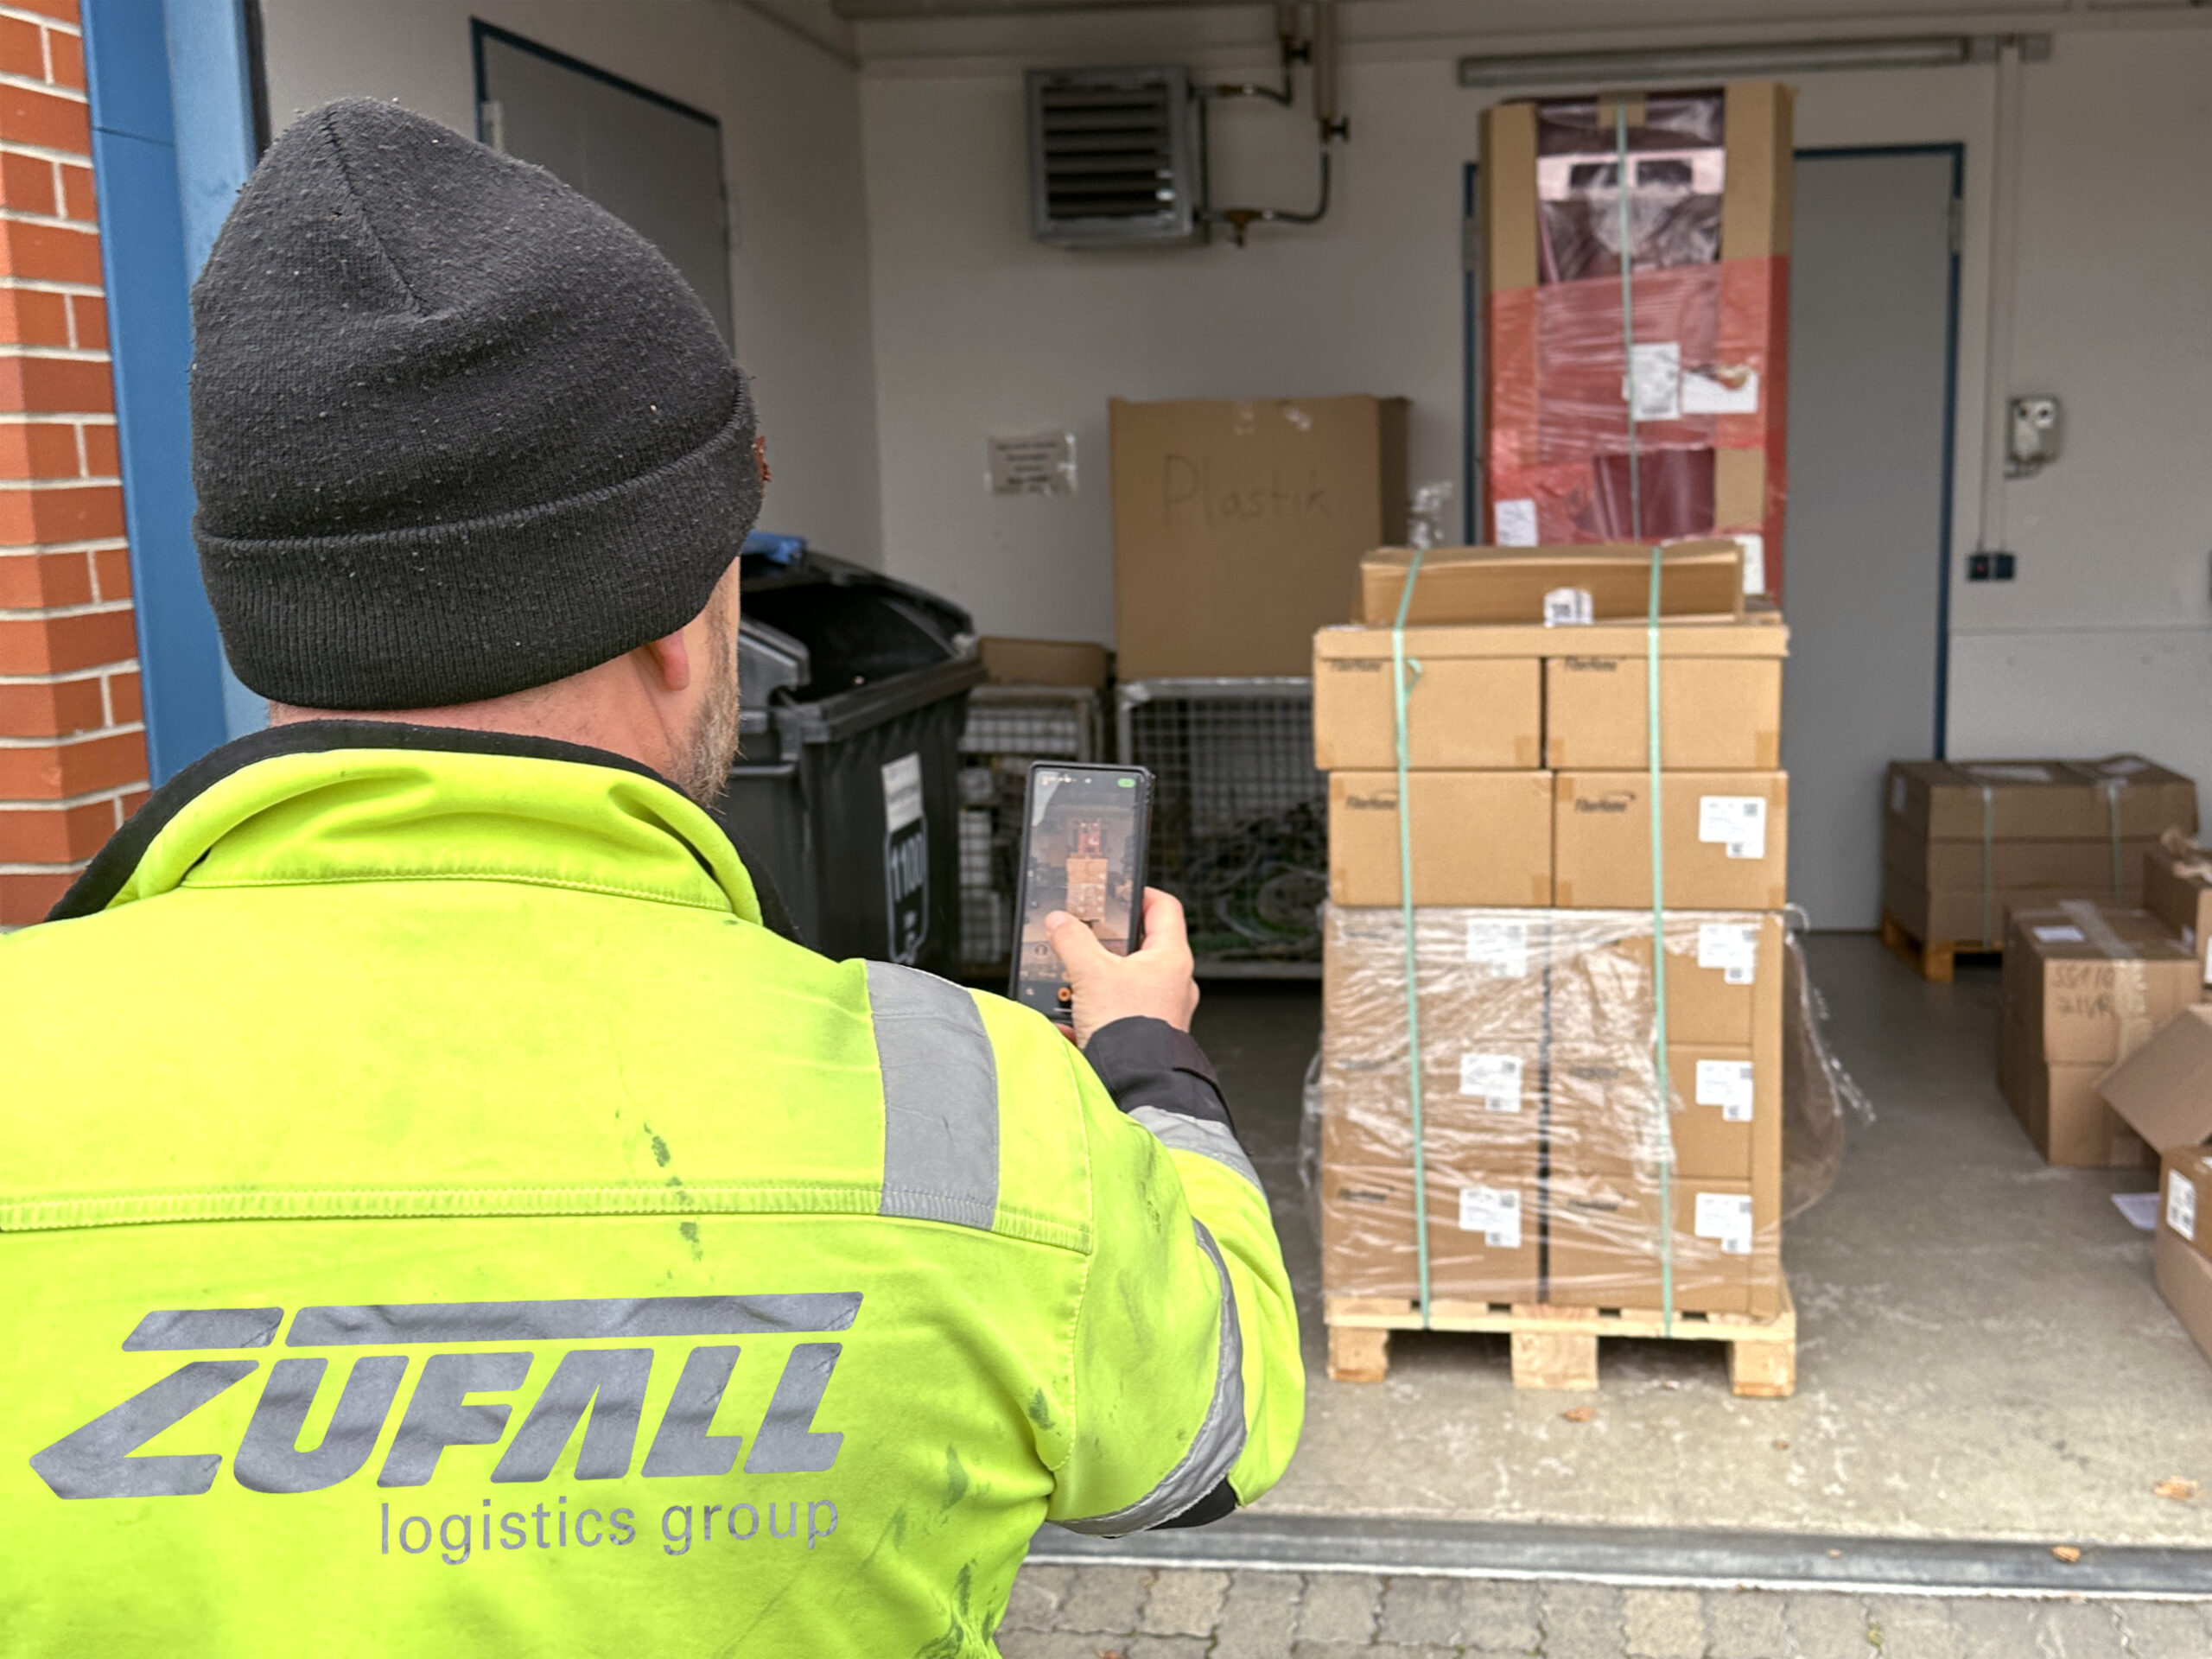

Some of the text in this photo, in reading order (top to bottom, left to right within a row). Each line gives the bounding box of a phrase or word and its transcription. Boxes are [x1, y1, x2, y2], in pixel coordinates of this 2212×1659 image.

[1162, 454, 1332, 528] Plastik
[29, 1291, 864, 1501] ZUFALL
[380, 1497, 840, 1565] logistics group
